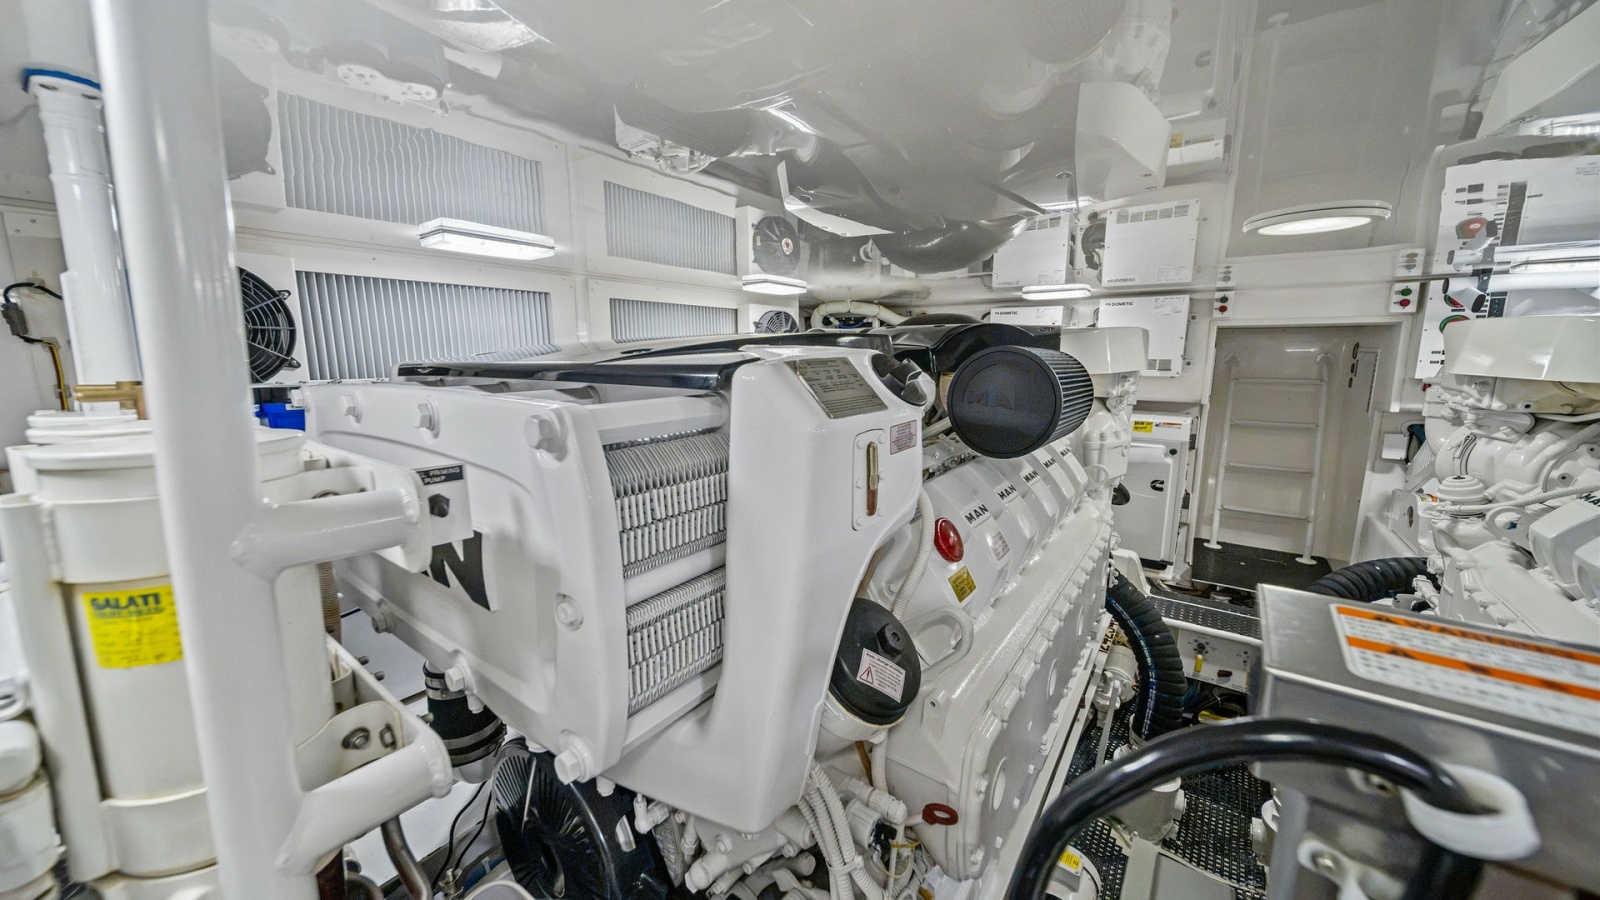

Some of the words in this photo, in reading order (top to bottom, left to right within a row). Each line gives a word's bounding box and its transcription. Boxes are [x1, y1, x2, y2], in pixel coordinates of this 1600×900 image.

[1043, 457, 1057, 469] MAN
[430, 467, 460, 476] PRIMING
[1023, 469, 1039, 483] MAN
[424, 475, 446, 483] PUMP
[997, 485, 1017, 500] MAN
[964, 504, 989, 525] MAN
[91, 593, 160, 610] SALATI
